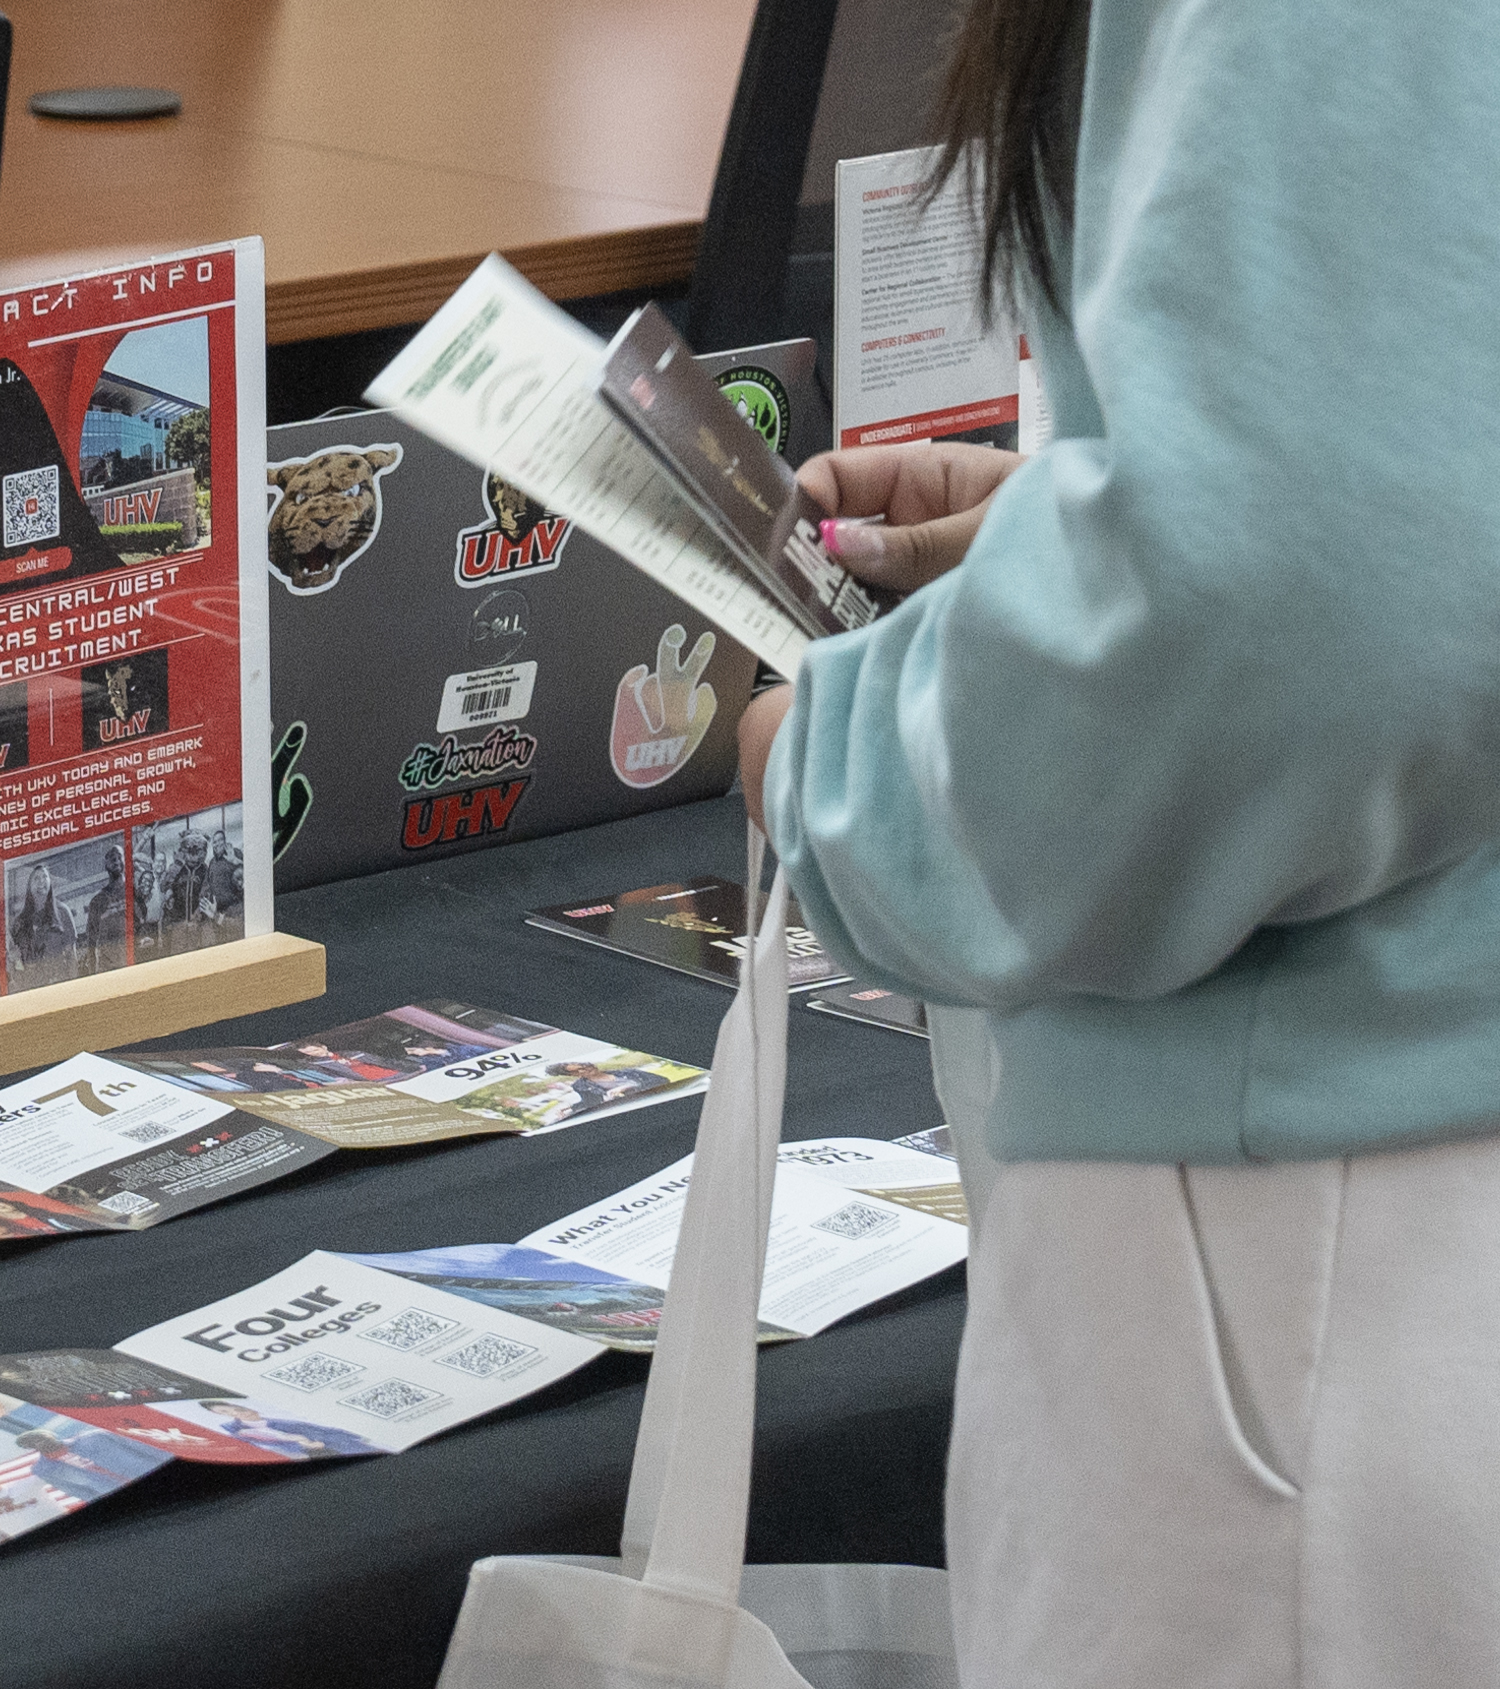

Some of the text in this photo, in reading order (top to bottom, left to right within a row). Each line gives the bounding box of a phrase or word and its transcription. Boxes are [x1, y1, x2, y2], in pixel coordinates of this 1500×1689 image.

[113, 261, 213, 300] INFO
[6, 366, 21, 383] Jr.
[104, 488, 163, 526] UHV
[462, 517, 569, 579] UHV
[49, 598, 159, 641] STUDENT
[100, 708, 151, 742] UHV
[27, 775, 56, 792] UHV
[62, 762, 109, 784] TODAY
[114, 753, 142, 770] AND
[147, 737, 204, 761] EMBARK
[624, 736, 688, 772] UHV
[55, 775, 132, 802] PERSONAL
[402, 780, 528, 851] UHV
[444, 1052, 543, 1082] 94%
[35, 1079, 138, 1118] 7th
[264, 1087, 398, 1110] Jaguar
[548, 1213, 618, 1247] What
[183, 1284, 343, 1354] Four
[236, 1300, 383, 1365] Colleges
